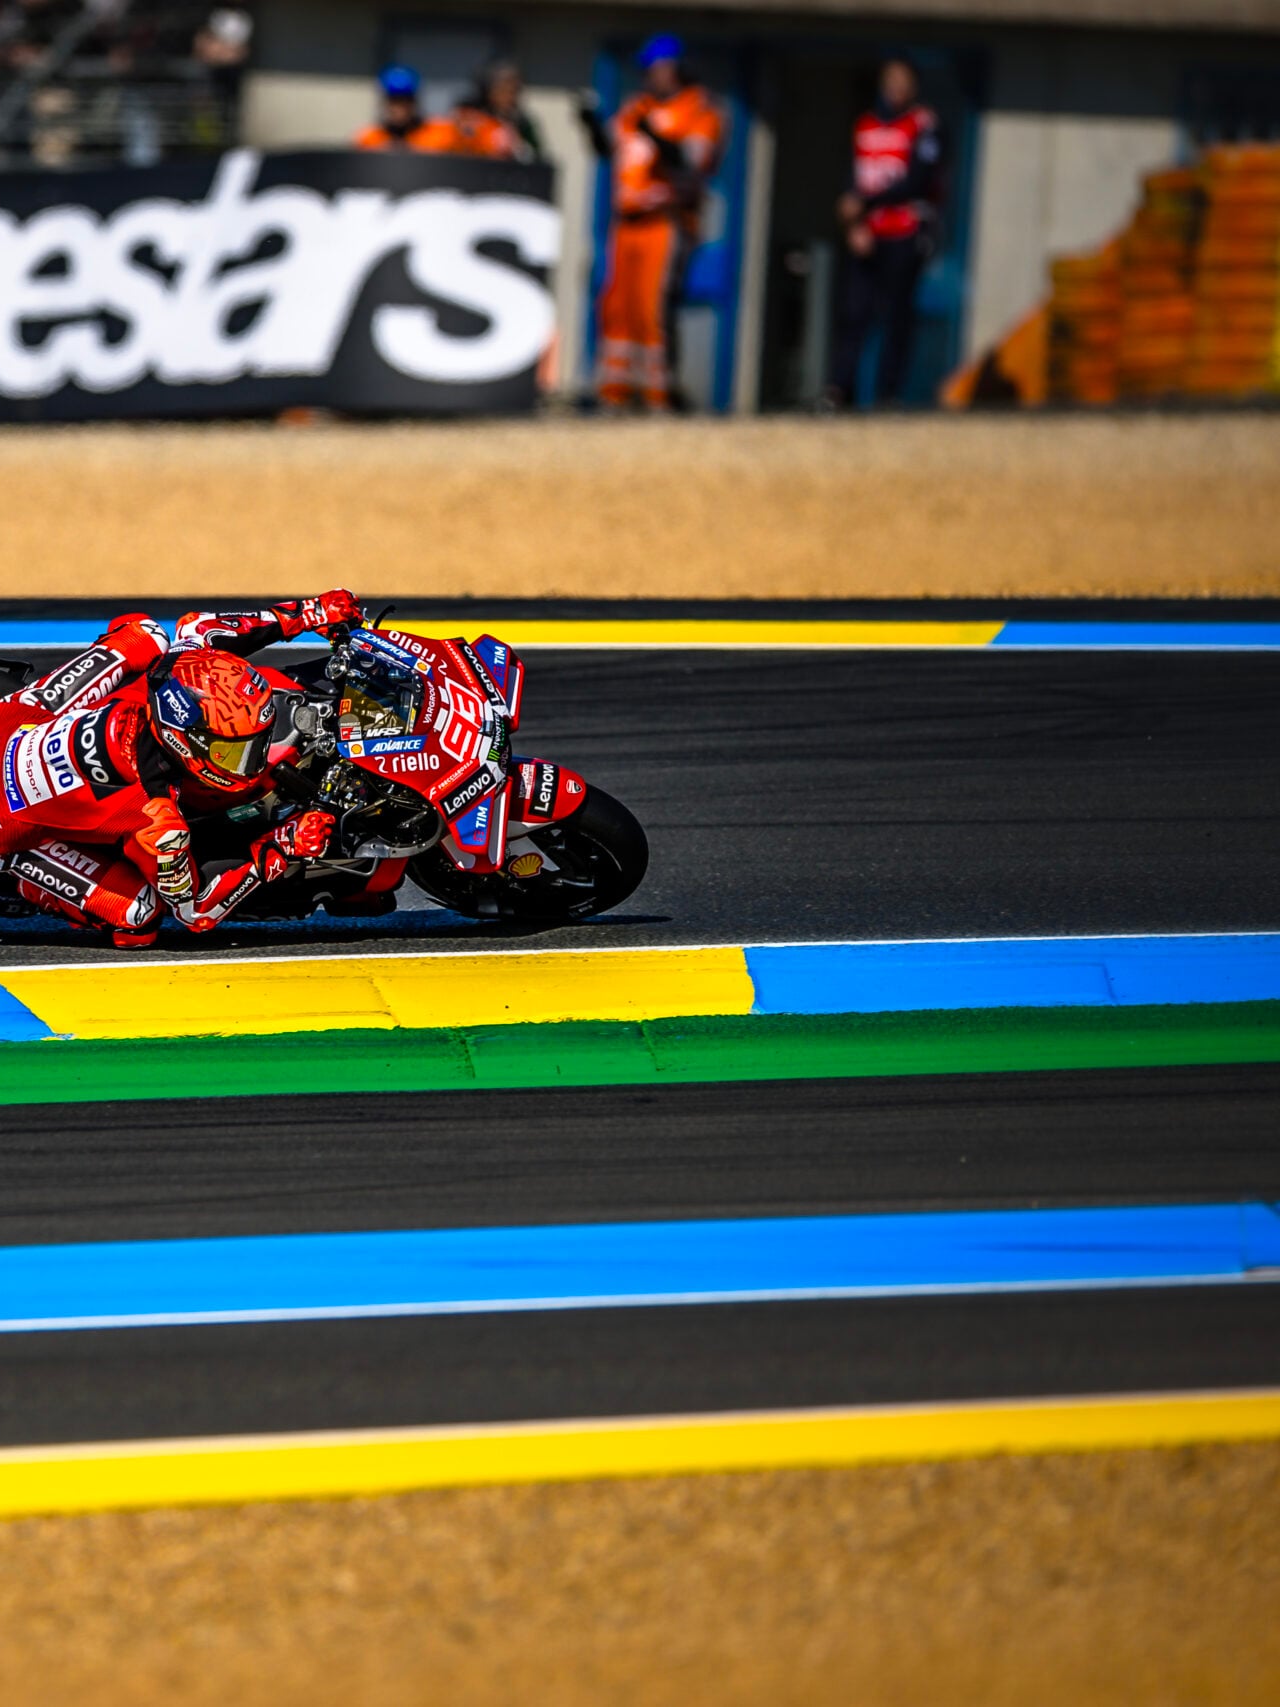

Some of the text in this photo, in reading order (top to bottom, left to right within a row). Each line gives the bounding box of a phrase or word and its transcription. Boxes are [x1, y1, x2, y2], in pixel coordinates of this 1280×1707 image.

[360, 631, 412, 659] ADVANCE
[388, 631, 436, 662] riello
[494, 645, 506, 665] TIM
[43, 652, 108, 702] Lenovo
[464, 645, 499, 705] Lenovo
[163, 689, 189, 721] next
[439, 677, 484, 763] 93
[81, 704, 111, 784] novo
[166, 733, 189, 757] SHOEI
[366, 727, 404, 738] WRS
[370, 739, 421, 753] ADVANCE
[5, 737, 19, 801] MICHELIN
[202, 769, 232, 786] Lenovo
[392, 753, 440, 773] riello
[438, 760, 473, 790] FRECCIAROSSA
[26, 760, 42, 799] Sport
[443, 772, 491, 815] Lenovo
[476, 806, 488, 828] TIM
[11, 854, 78, 897] Lenovo
[223, 876, 254, 907] Lenovo
